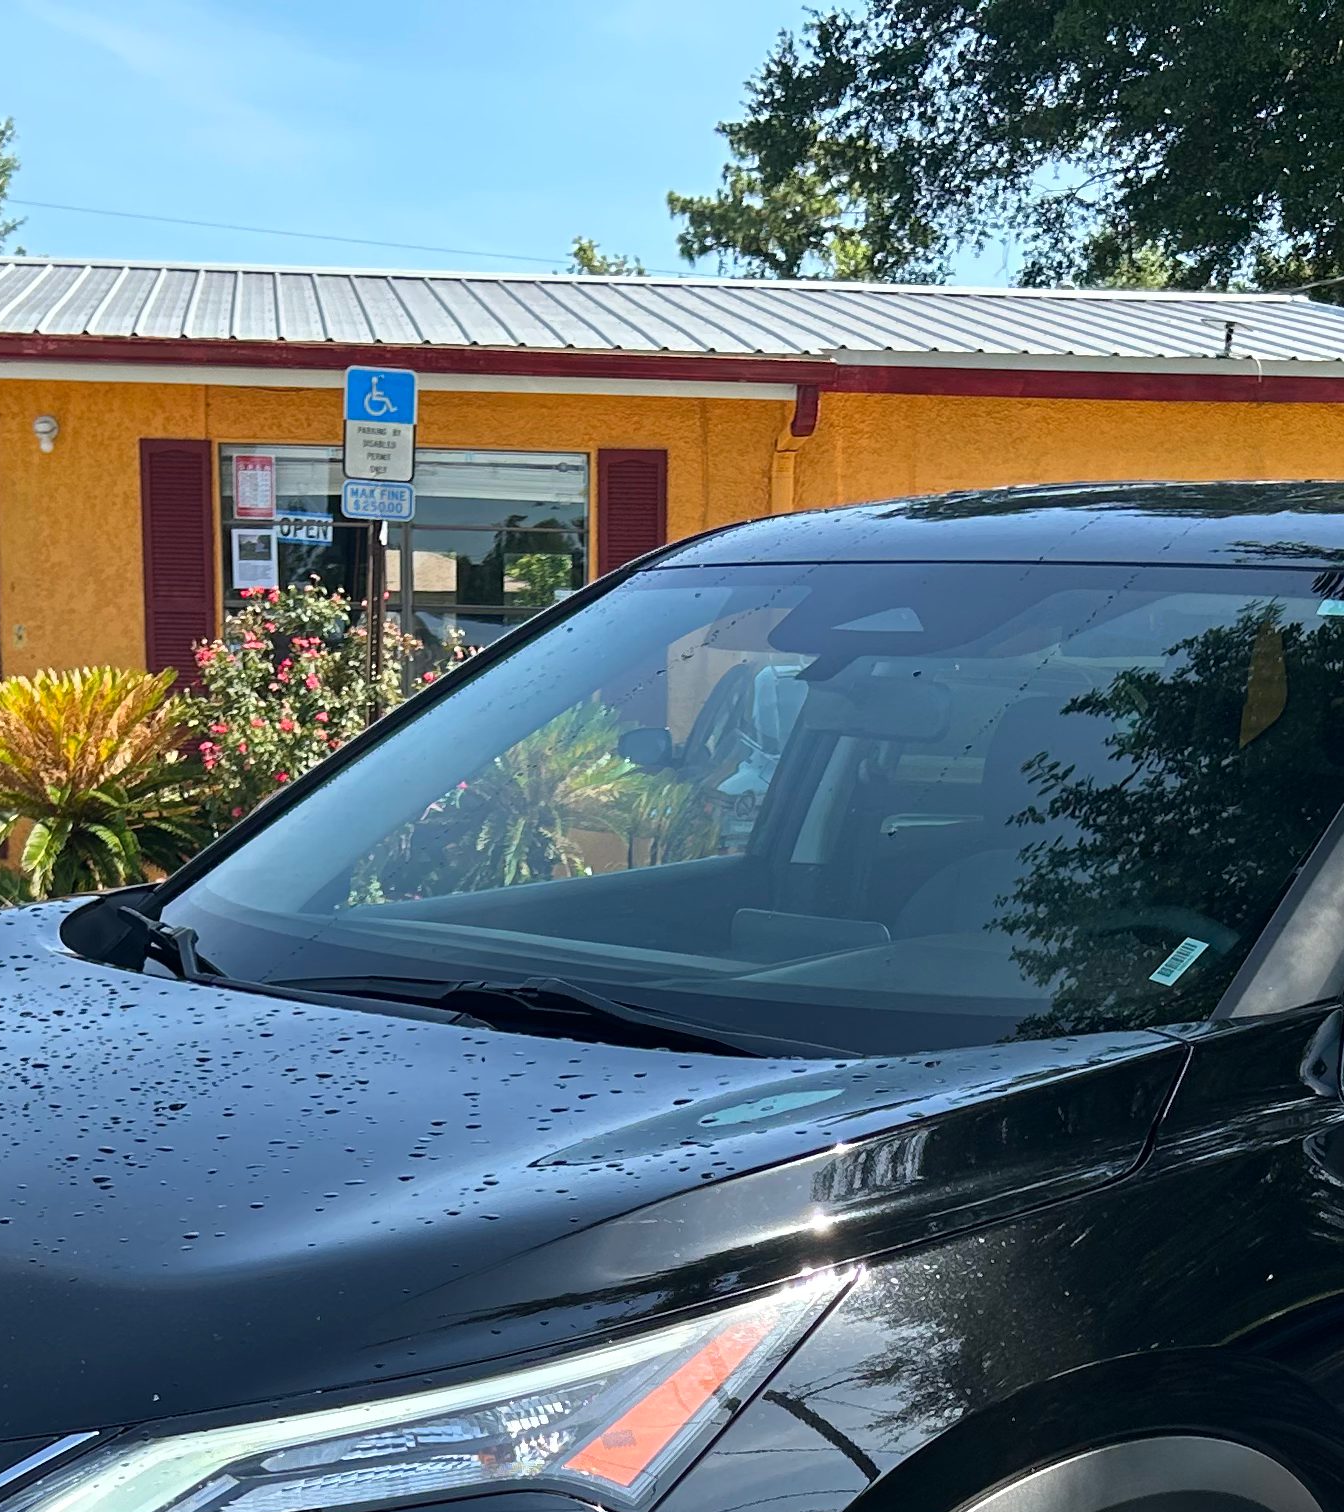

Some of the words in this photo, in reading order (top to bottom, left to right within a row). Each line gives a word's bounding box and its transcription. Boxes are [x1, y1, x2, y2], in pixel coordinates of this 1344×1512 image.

[357, 427, 387, 436] PARKING
[362, 440, 396, 449] DISABLED
[367, 452, 391, 460] PERMIT
[370, 465, 388, 474] ONLY
[350, 488, 375, 499] MAX
[380, 489, 406, 501] FINE
[280, 517, 329, 540] OPEN
